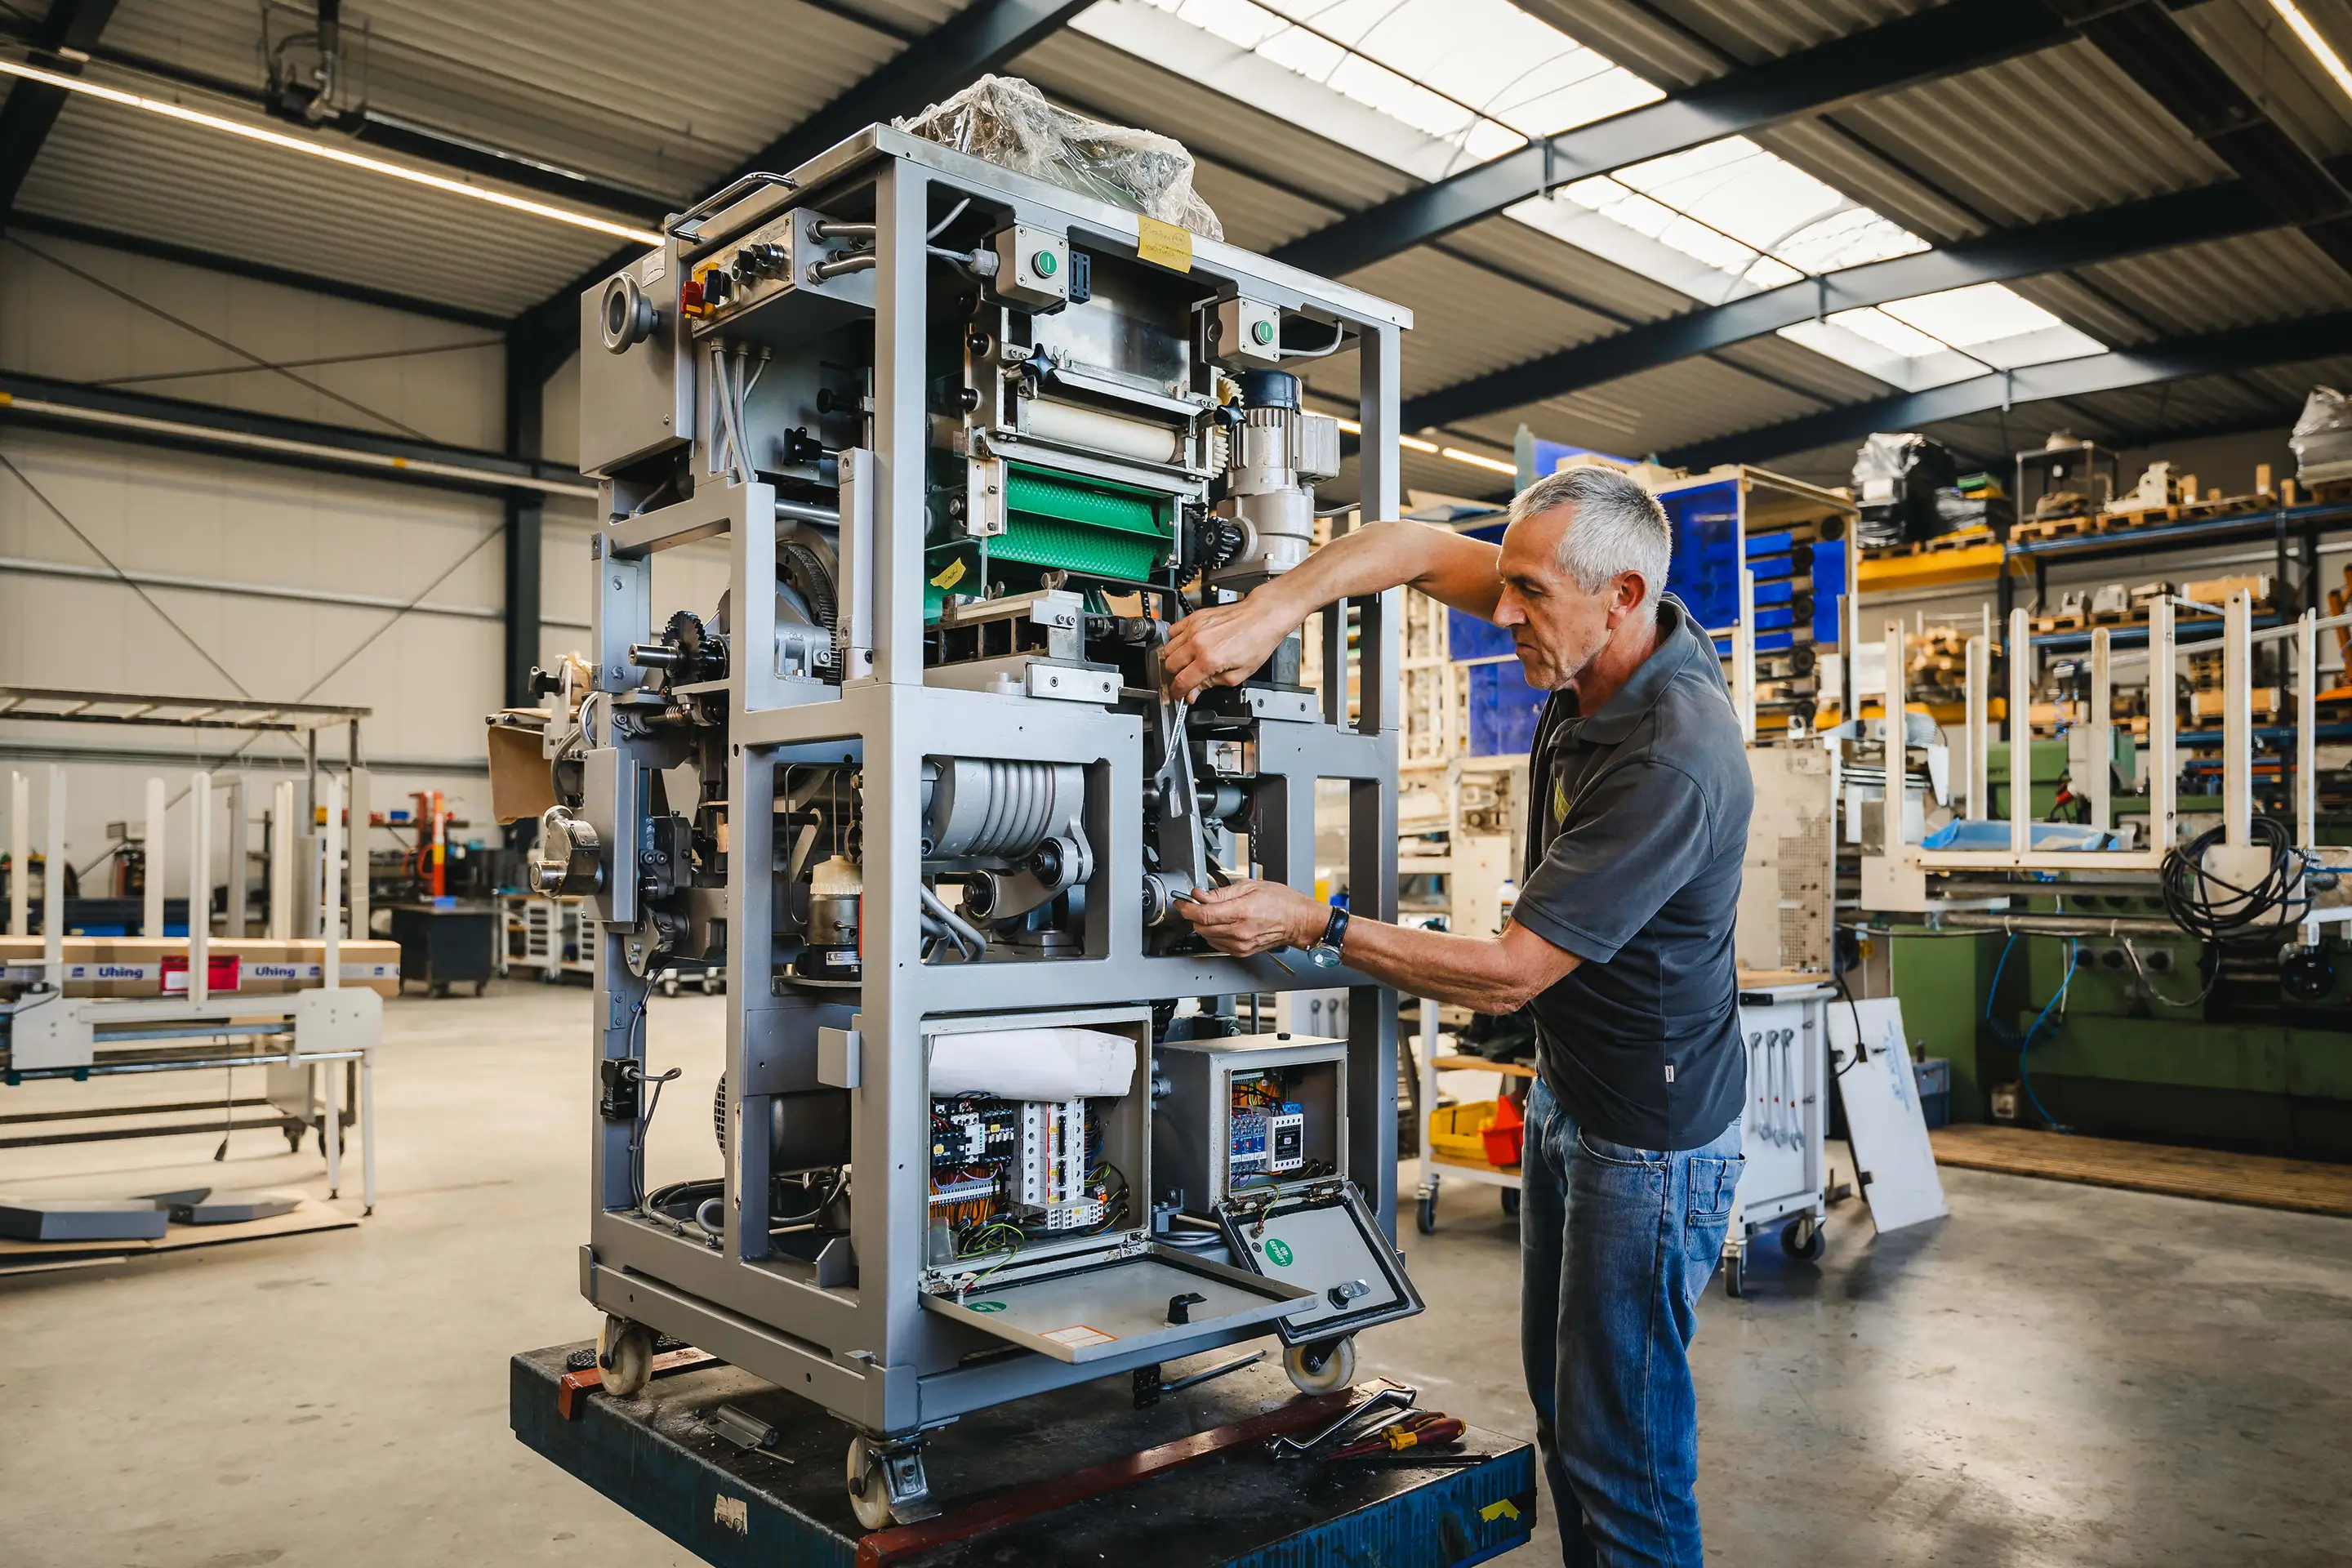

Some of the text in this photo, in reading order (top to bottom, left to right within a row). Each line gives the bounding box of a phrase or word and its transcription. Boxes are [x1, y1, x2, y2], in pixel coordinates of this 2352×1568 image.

[99, 967, 144, 979] Uhing
[256, 966, 296, 978] Uhing
[1269, 1241, 1286, 1263] GEPRÜFT
[1281, 1247, 1289, 1257] QM-
